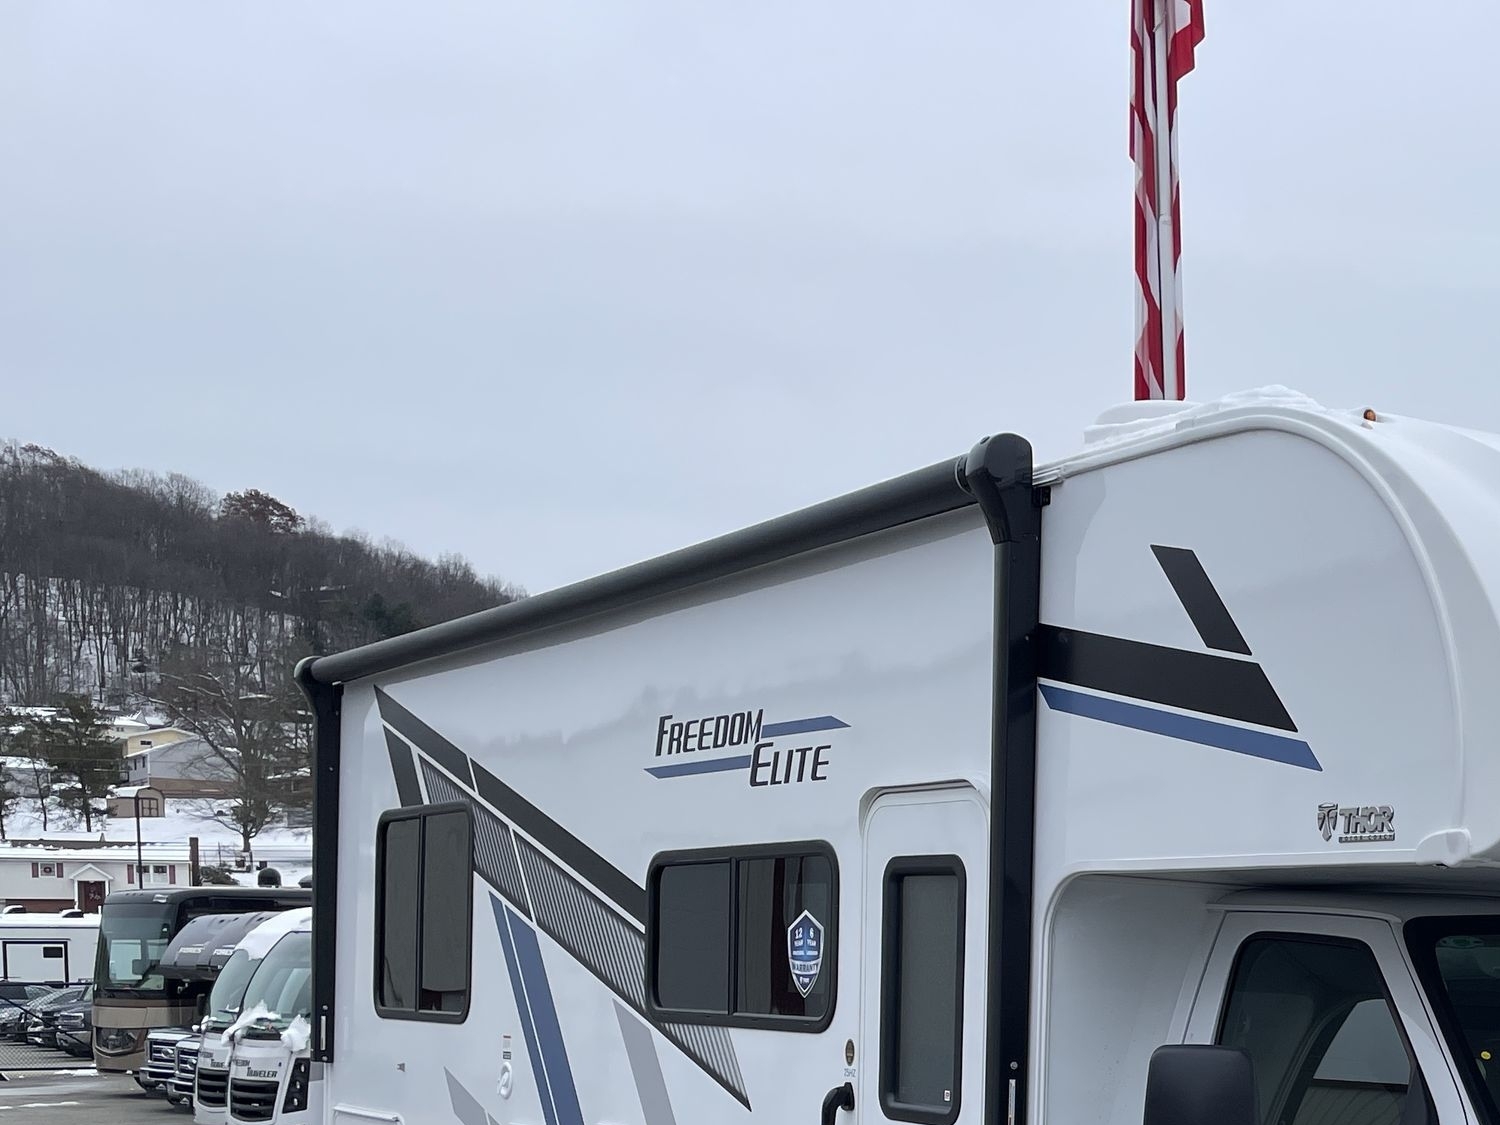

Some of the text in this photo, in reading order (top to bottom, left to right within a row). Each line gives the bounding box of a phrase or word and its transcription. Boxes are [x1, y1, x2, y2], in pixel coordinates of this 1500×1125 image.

[655, 709, 764, 757] FREEDOM
[750, 742, 832, 787] ELITE
[1339, 805, 1395, 834] THOR
[795, 927, 803, 939] 12
[809, 927, 814, 939] 6
[247, 1067, 278, 1078] TRAVELER
